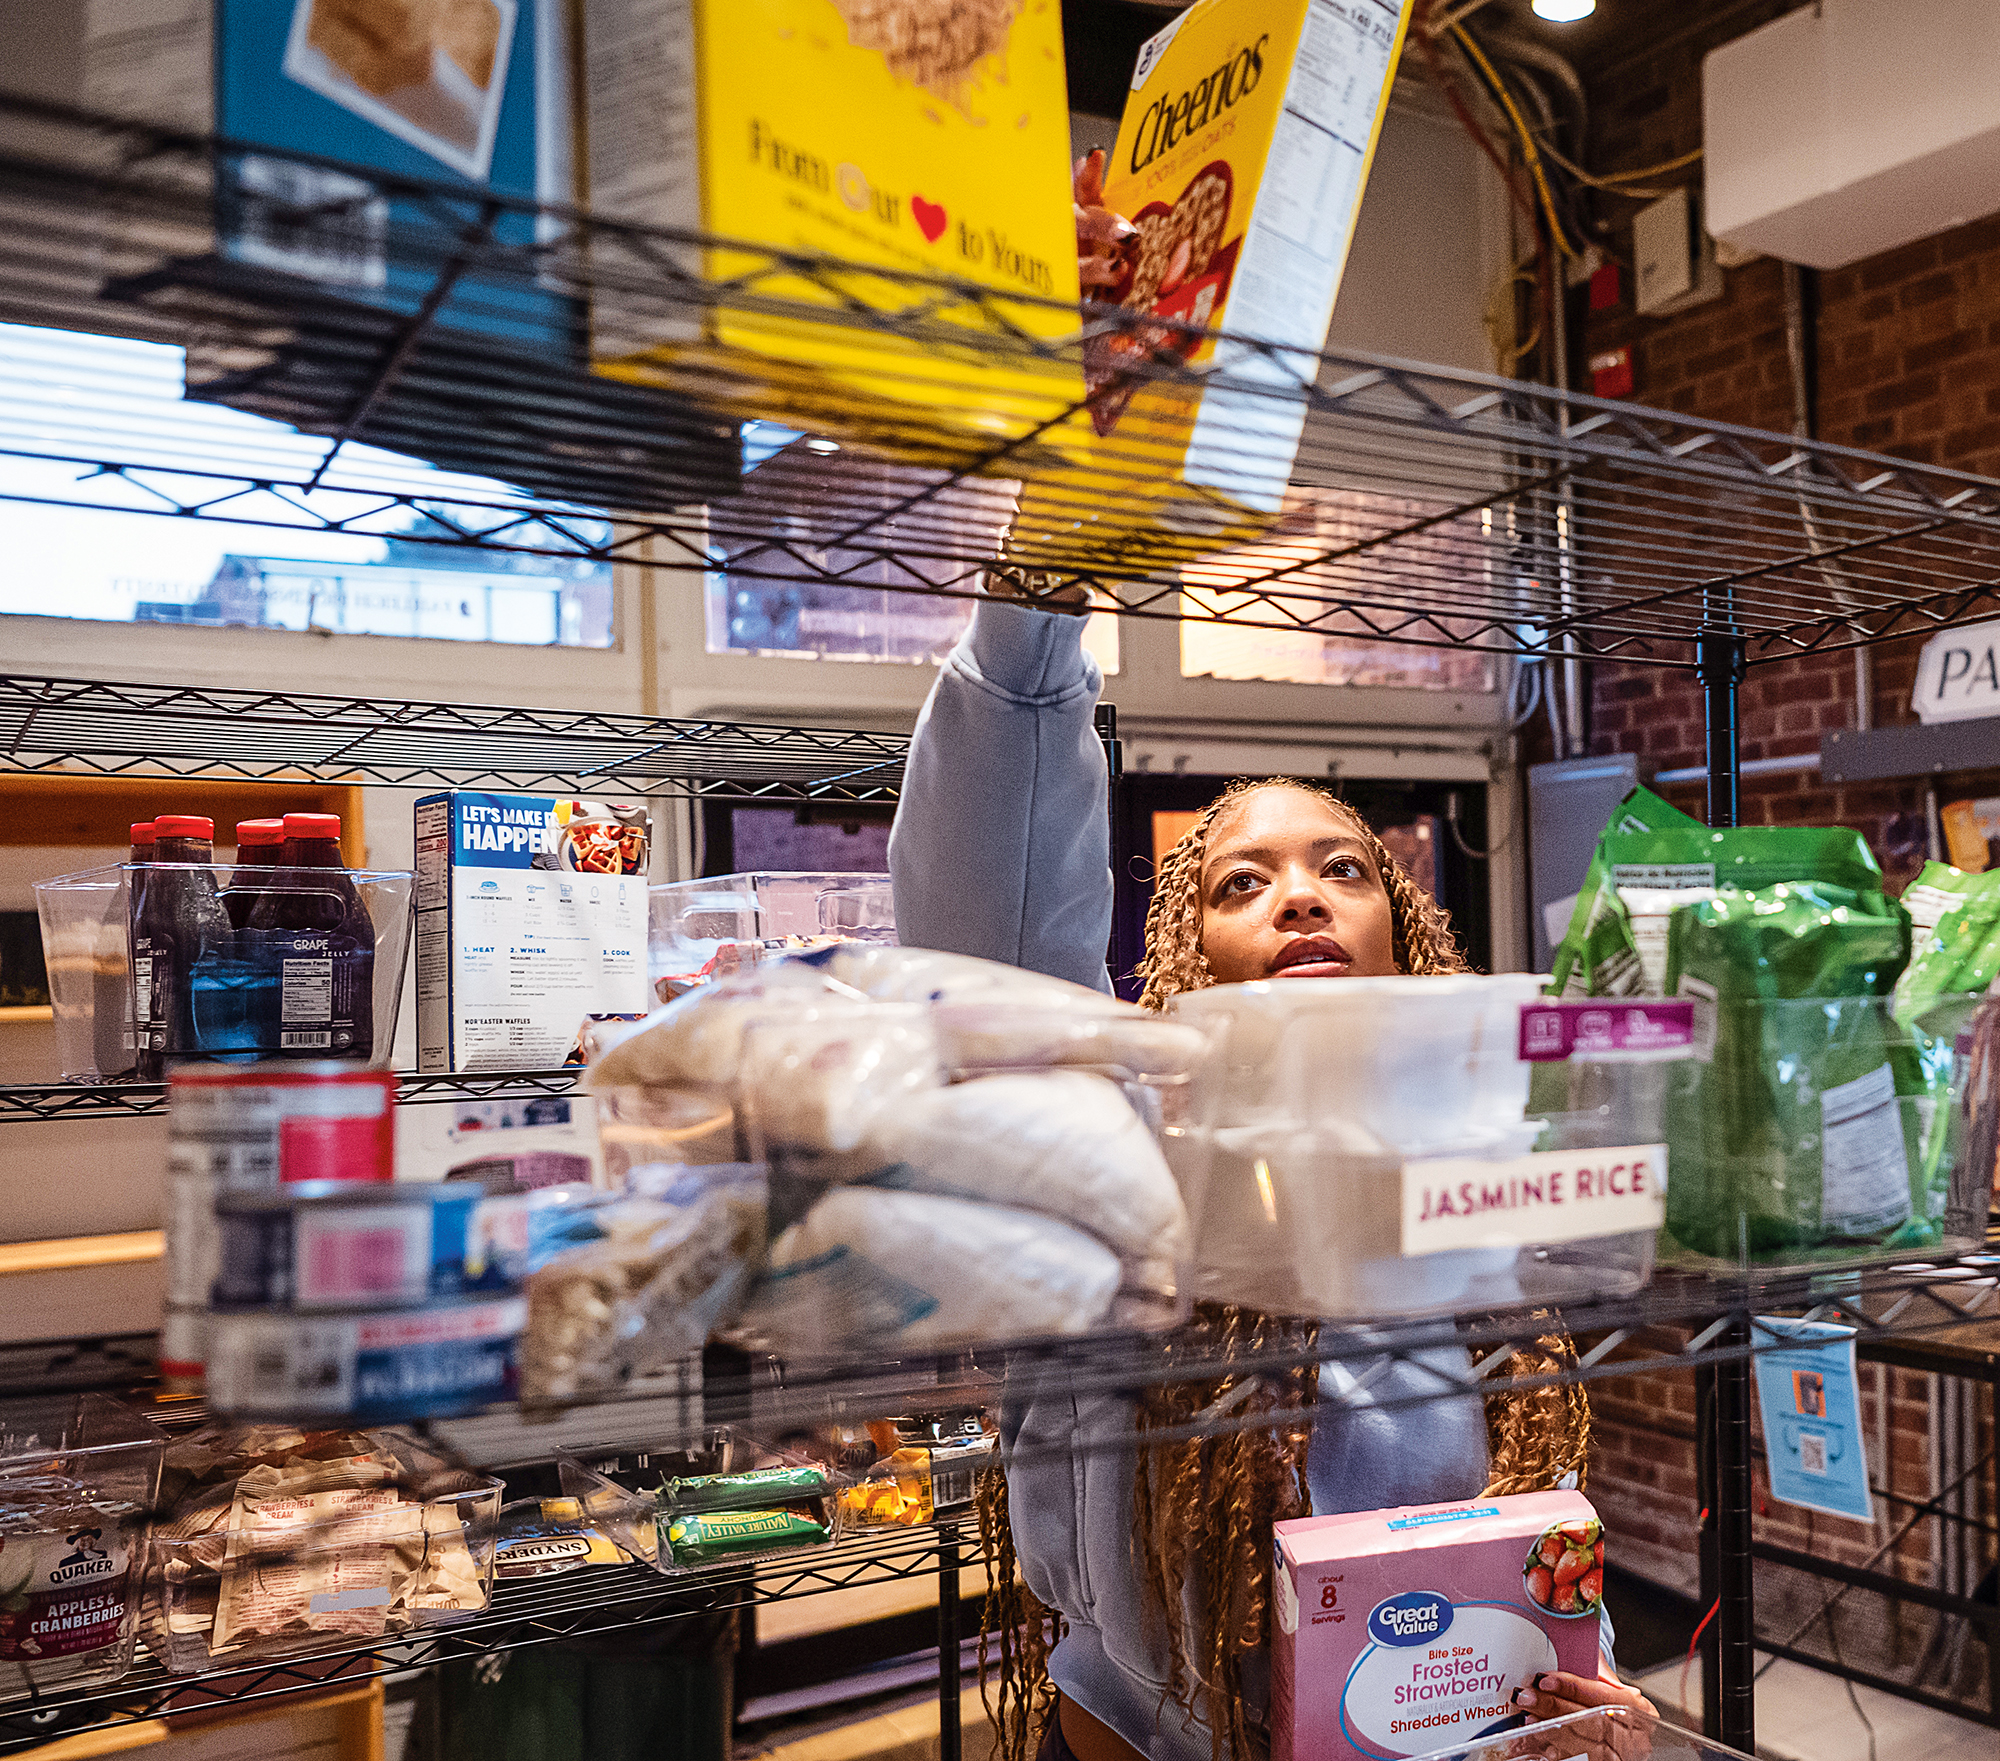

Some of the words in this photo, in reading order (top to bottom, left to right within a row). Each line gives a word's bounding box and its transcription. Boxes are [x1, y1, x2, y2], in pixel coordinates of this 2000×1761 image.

[1131, 33, 1269, 174] Cheerios
[748, 117, 830, 194] From
[958, 218, 984, 263] to
[1938, 646, 1999, 699] PA
[462, 805, 500, 822] LET'S
[503, 809, 542, 826] MAKE
[462, 824, 558, 854] HAPPEN
[293, 939, 328, 950] GRAPE
[1419, 1172, 1564, 1222] JASMINE
[1575, 1162, 1648, 1199] RICE
[331, 1496, 387, 1505] STRAWBERRIES
[720, 1512, 768, 1523] CRUNCHY
[747, 1514, 788, 1533] NATURE
[707, 1524, 748, 1537] VALLEY
[50, 1560, 113, 1584] QUAKER
[1318, 1575, 1343, 1584] about
[48, 1596, 104, 1618] APPLES
[107, 1592, 115, 1605] &
[1320, 1584, 1337, 1609] 8
[31, 1603, 124, 1634] CRANBERRIES
[1311, 1614, 1345, 1625] Servings
[1379, 1603, 1439, 1625] Great
[1393, 1620, 1438, 1636] Value
[1428, 1649, 1448, 1660] Bite
[1452, 1646, 1474, 1657] Size
[1413, 1654, 1488, 1682] Frosted
[1394, 1674, 1506, 1704] Strawberry
[1390, 1710, 1460, 1734] Shredded
[1464, 1701, 1510, 1721] Wheat
